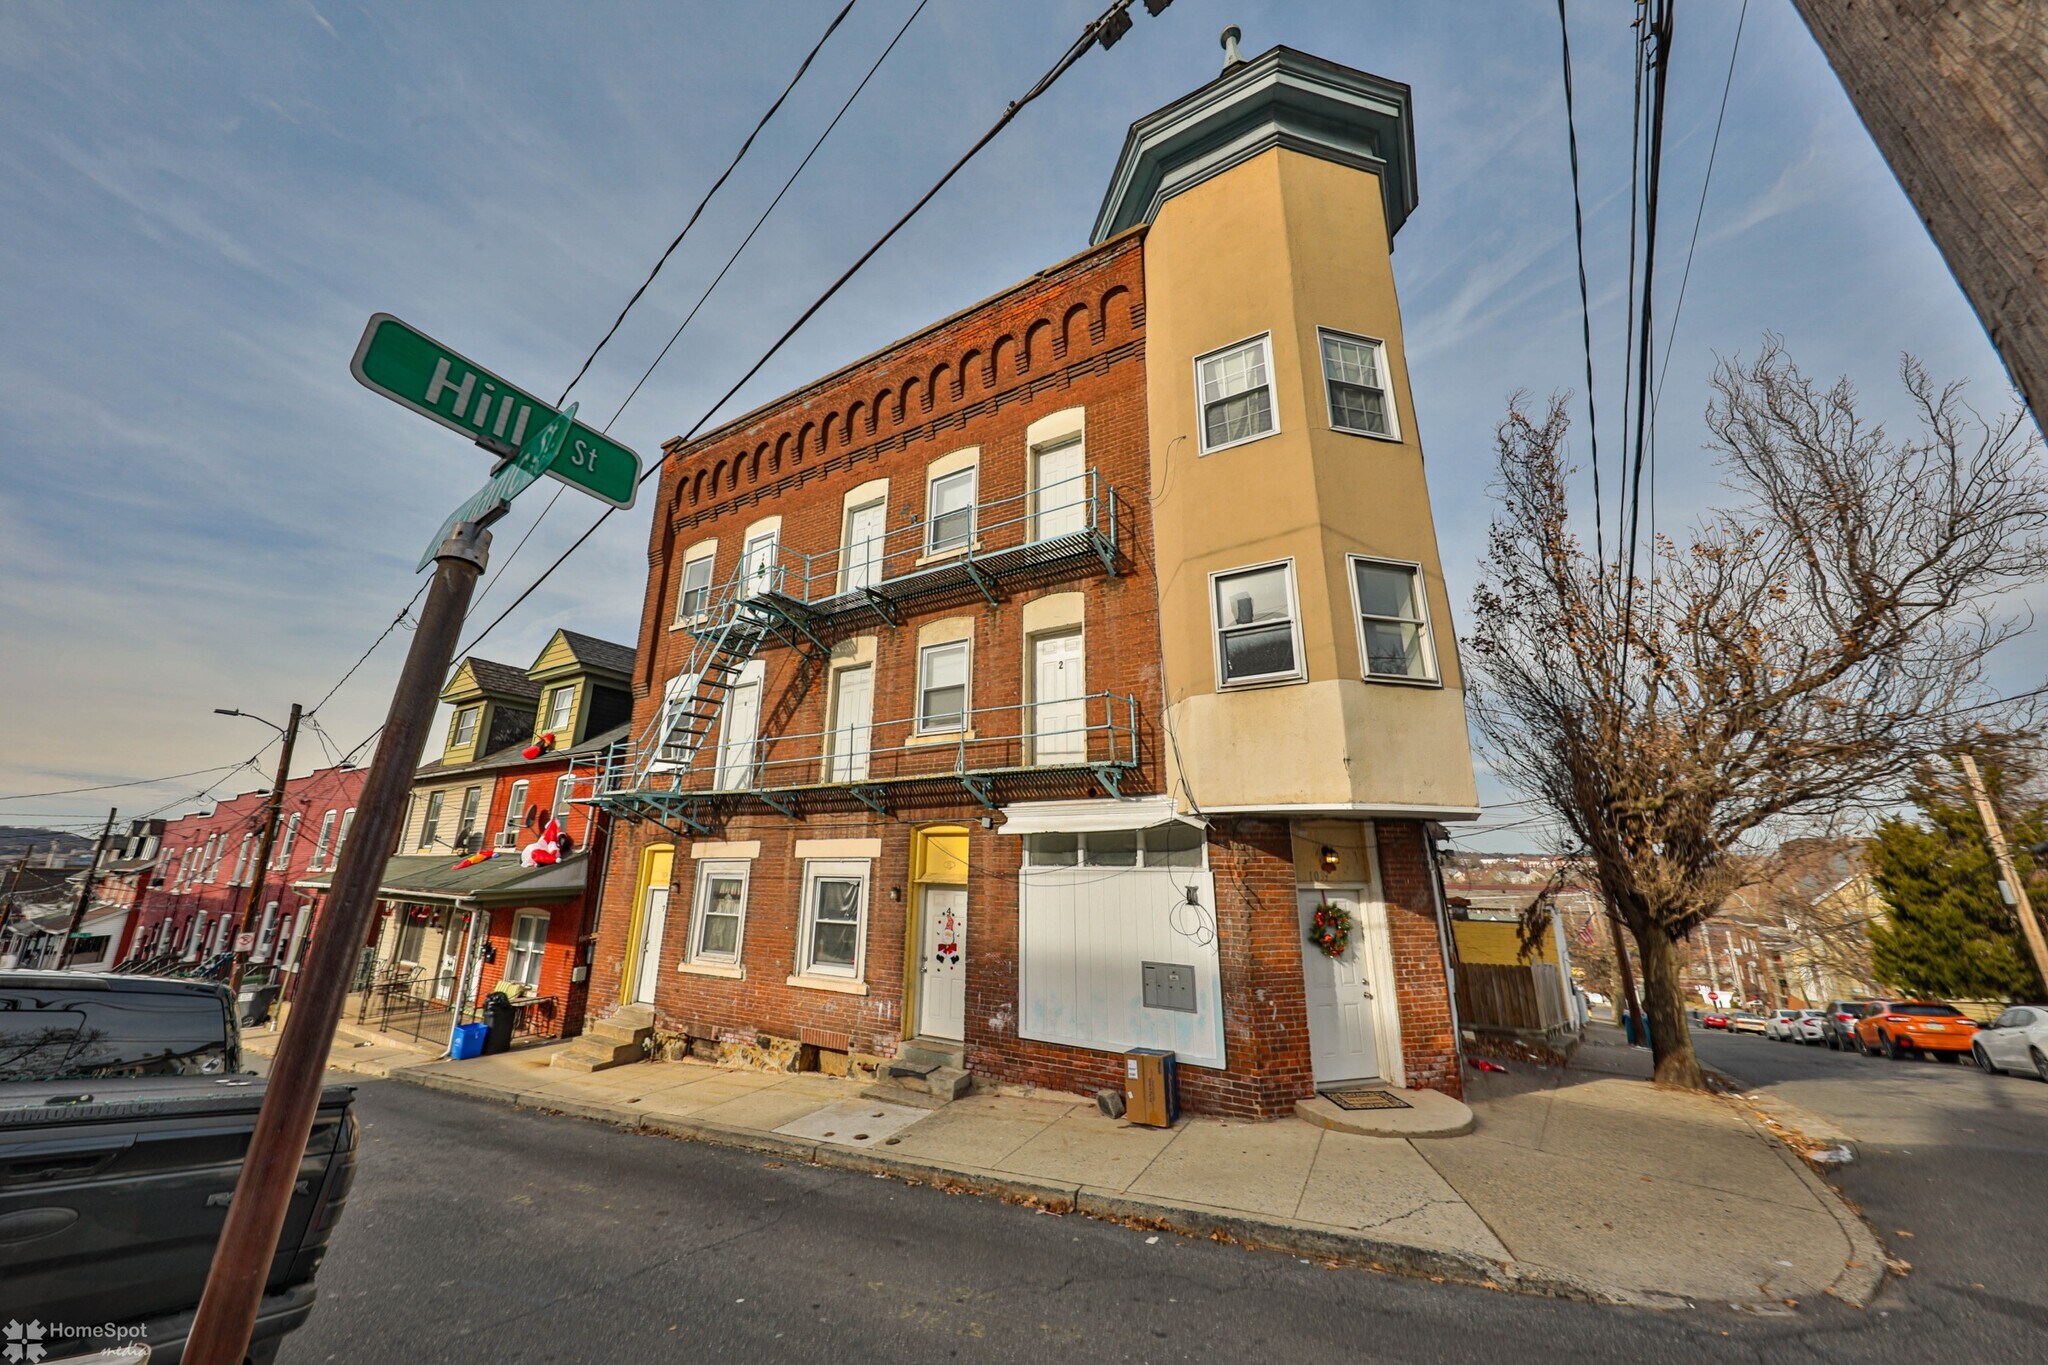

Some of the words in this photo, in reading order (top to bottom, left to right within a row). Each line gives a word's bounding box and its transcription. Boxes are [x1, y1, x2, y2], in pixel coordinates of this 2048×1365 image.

[424, 357, 532, 446] Hill
[570, 440, 598, 472] St
[1058, 660, 1064, 670] 2
